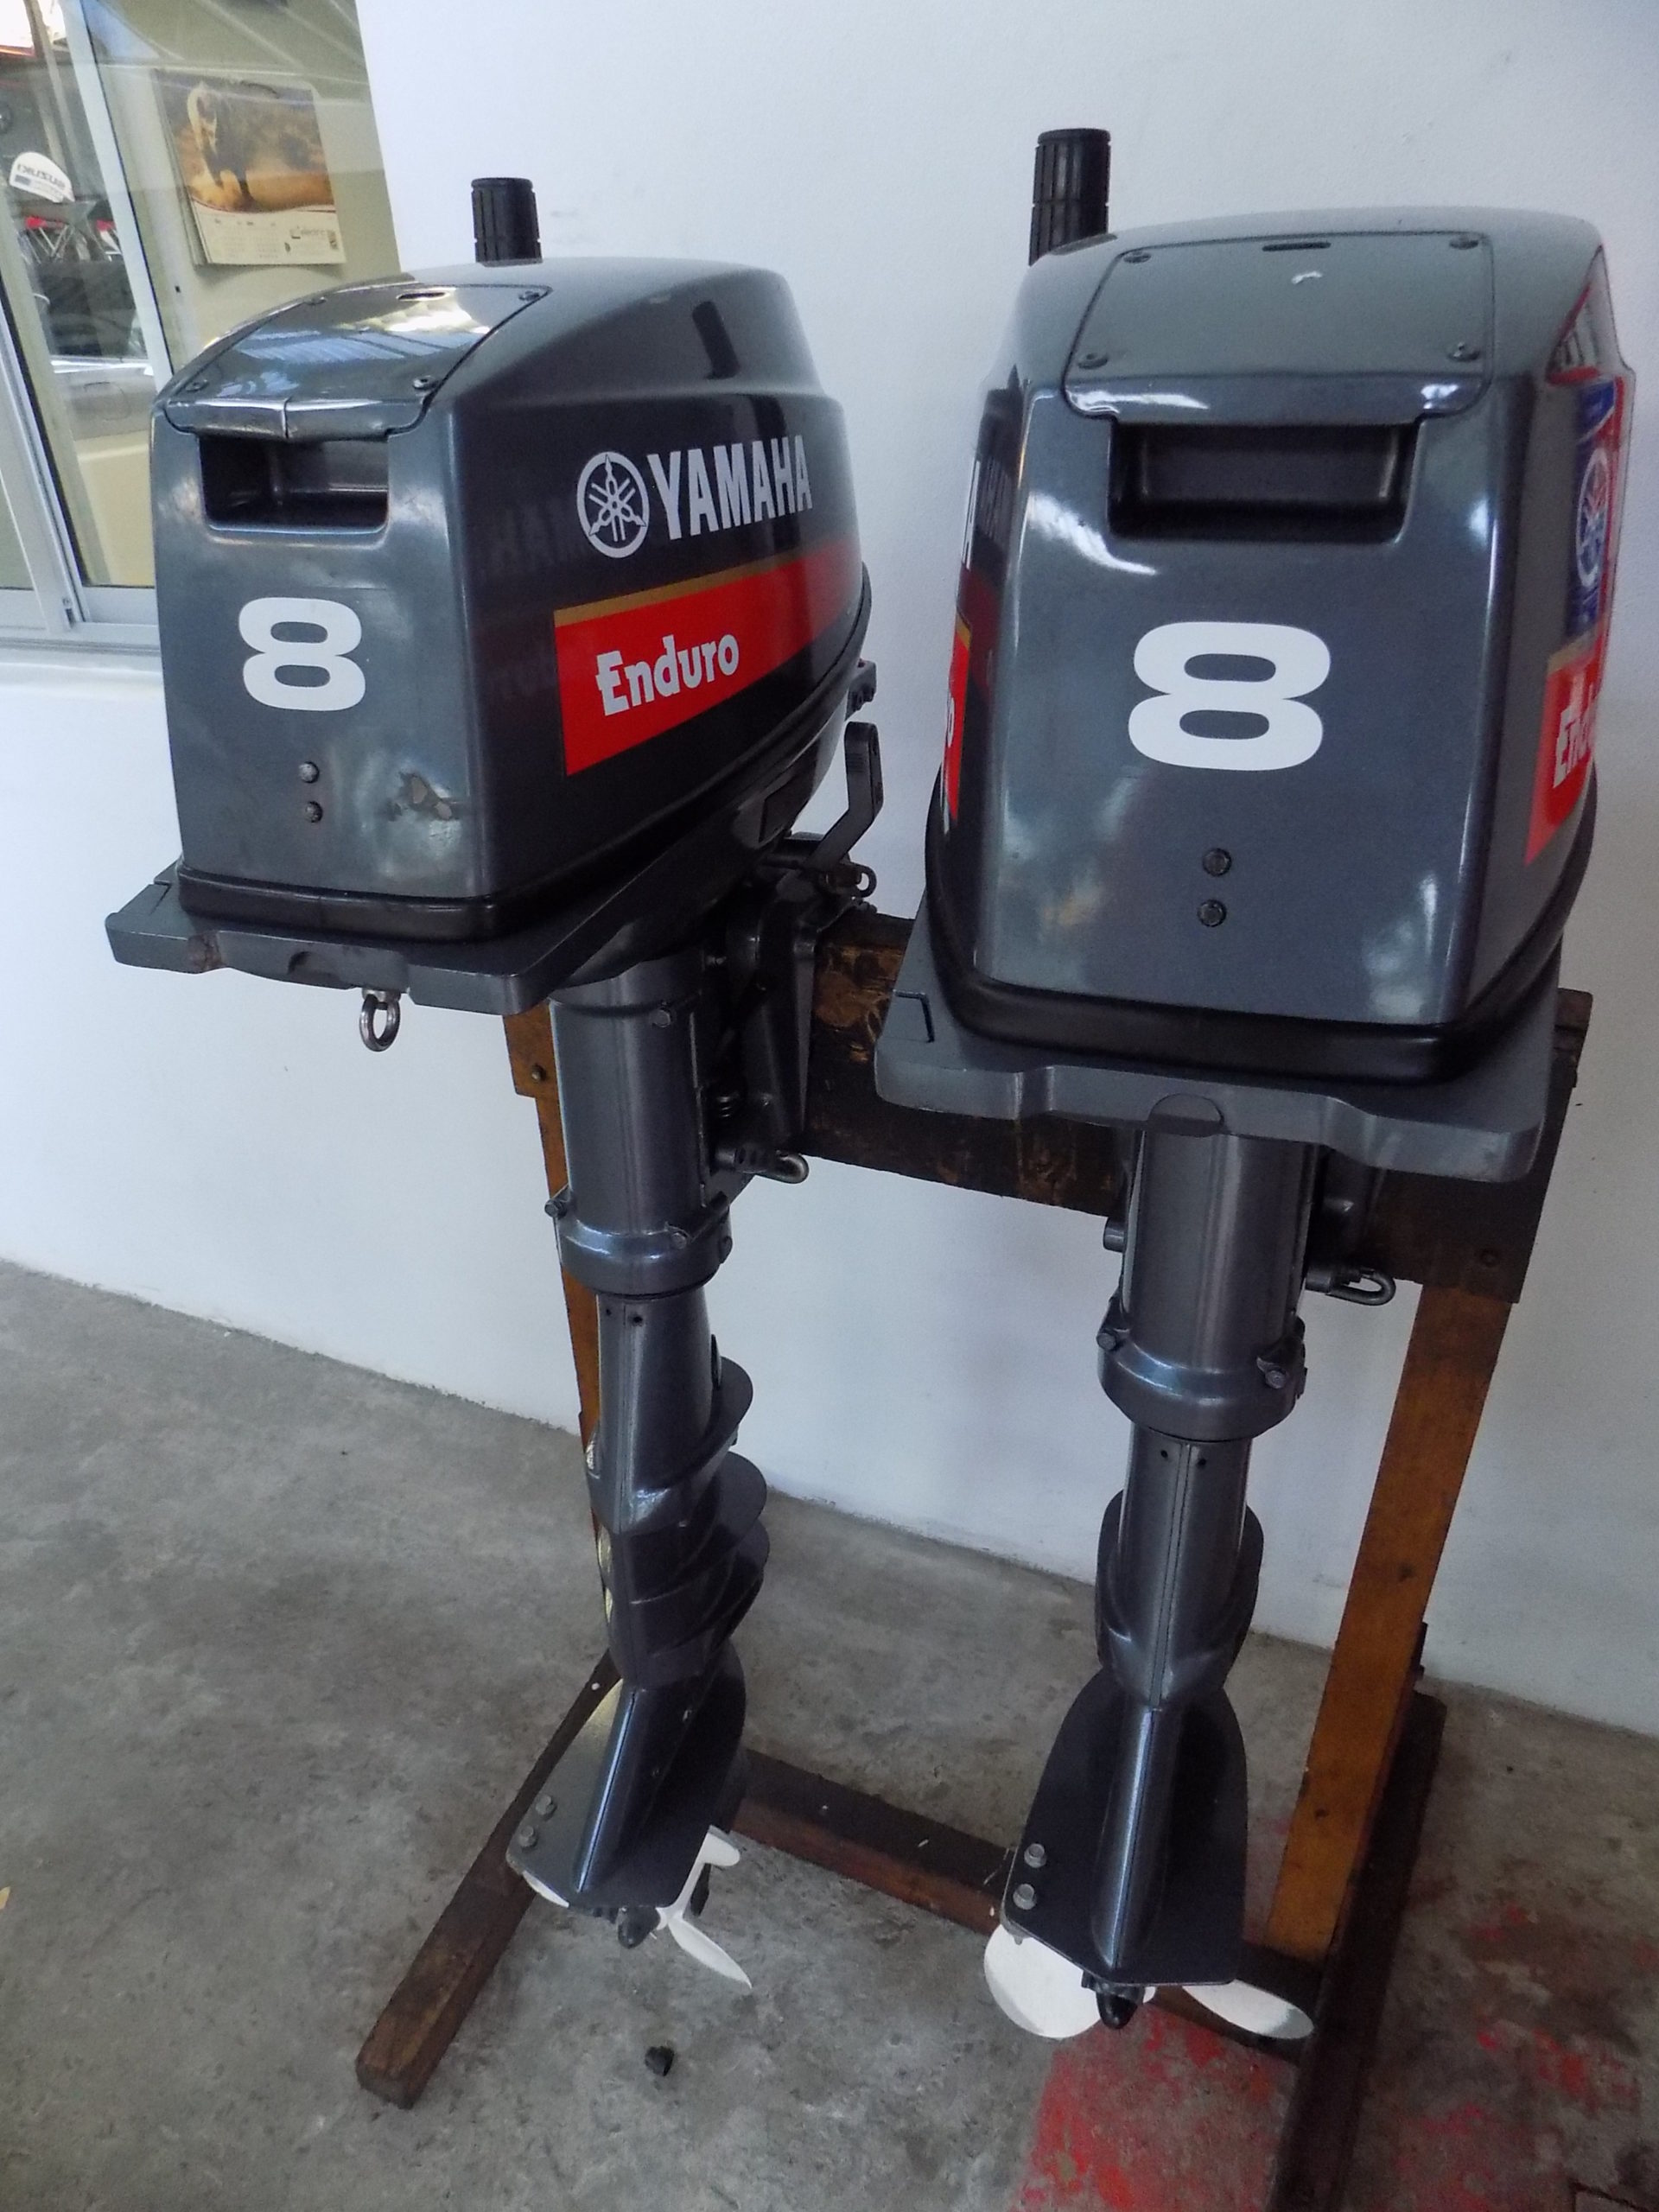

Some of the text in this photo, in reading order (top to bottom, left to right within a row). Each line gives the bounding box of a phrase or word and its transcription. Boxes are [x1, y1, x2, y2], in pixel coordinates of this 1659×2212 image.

[646, 435, 813, 541] YAMAHA
[238, 596, 366, 712] 8
[595, 633, 740, 716] Enduro
[1128, 620, 1332, 771] 8
